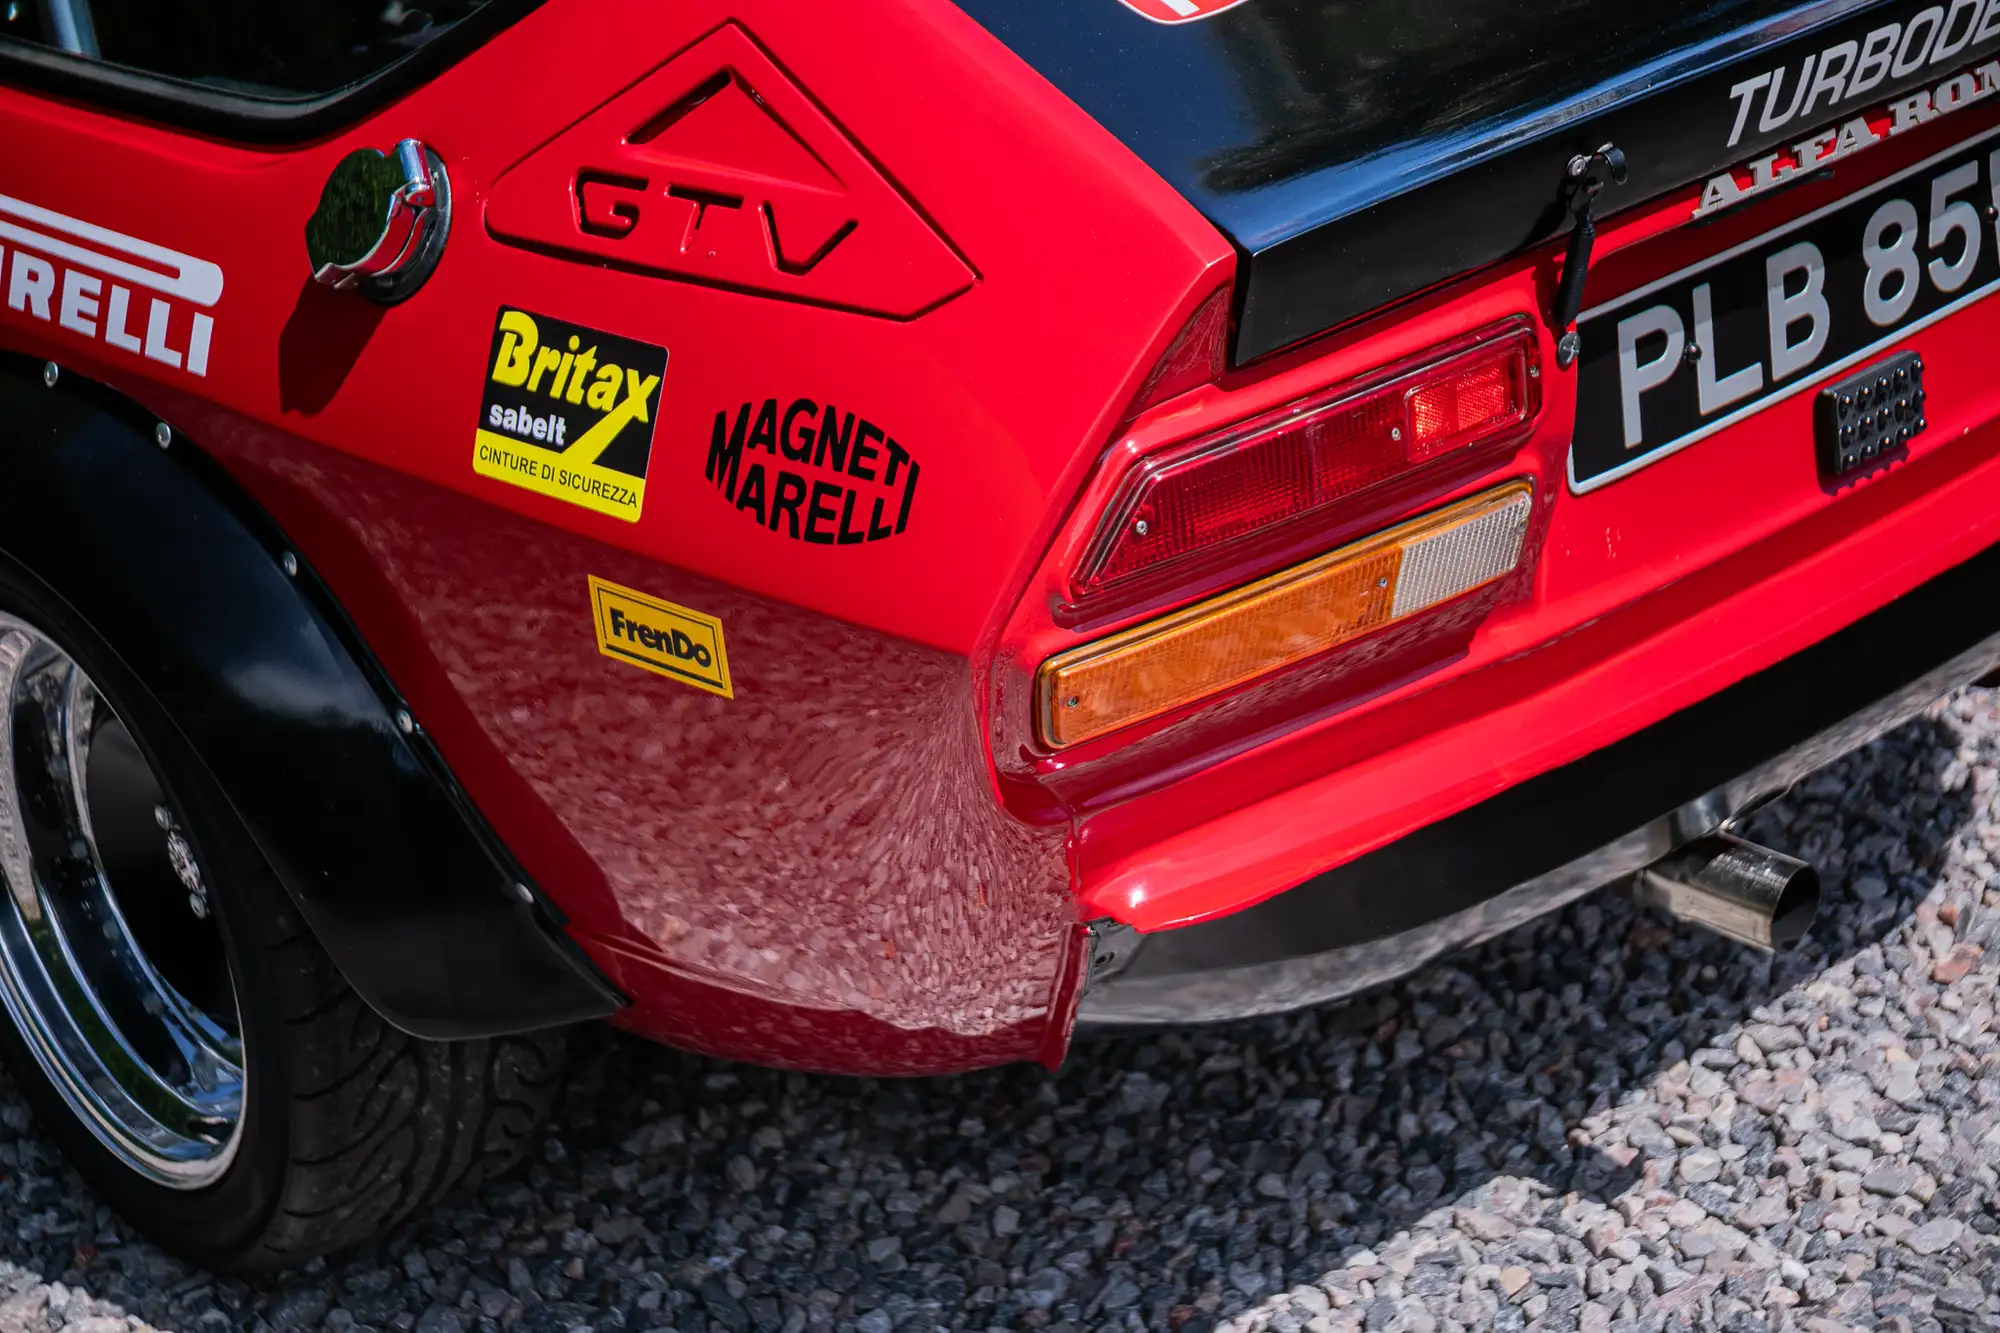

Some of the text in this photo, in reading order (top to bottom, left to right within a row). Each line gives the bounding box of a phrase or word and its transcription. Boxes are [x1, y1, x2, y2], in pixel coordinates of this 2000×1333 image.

[1691, 117, 1881, 219] ALFA
[570, 166, 859, 276] GTV
[0, 244, 214, 378] RELLI
[1618, 149, 2000, 449] PLB 85
[492, 311, 660, 424] Britax
[479, 445, 638, 508] CINTURE DI SICUREZZA
[489, 403, 567, 446] sabelt
[705, 398, 920, 505] MAGNETI
[705, 445, 920, 545] MARELLI
[609, 607, 711, 667] FrenDo
